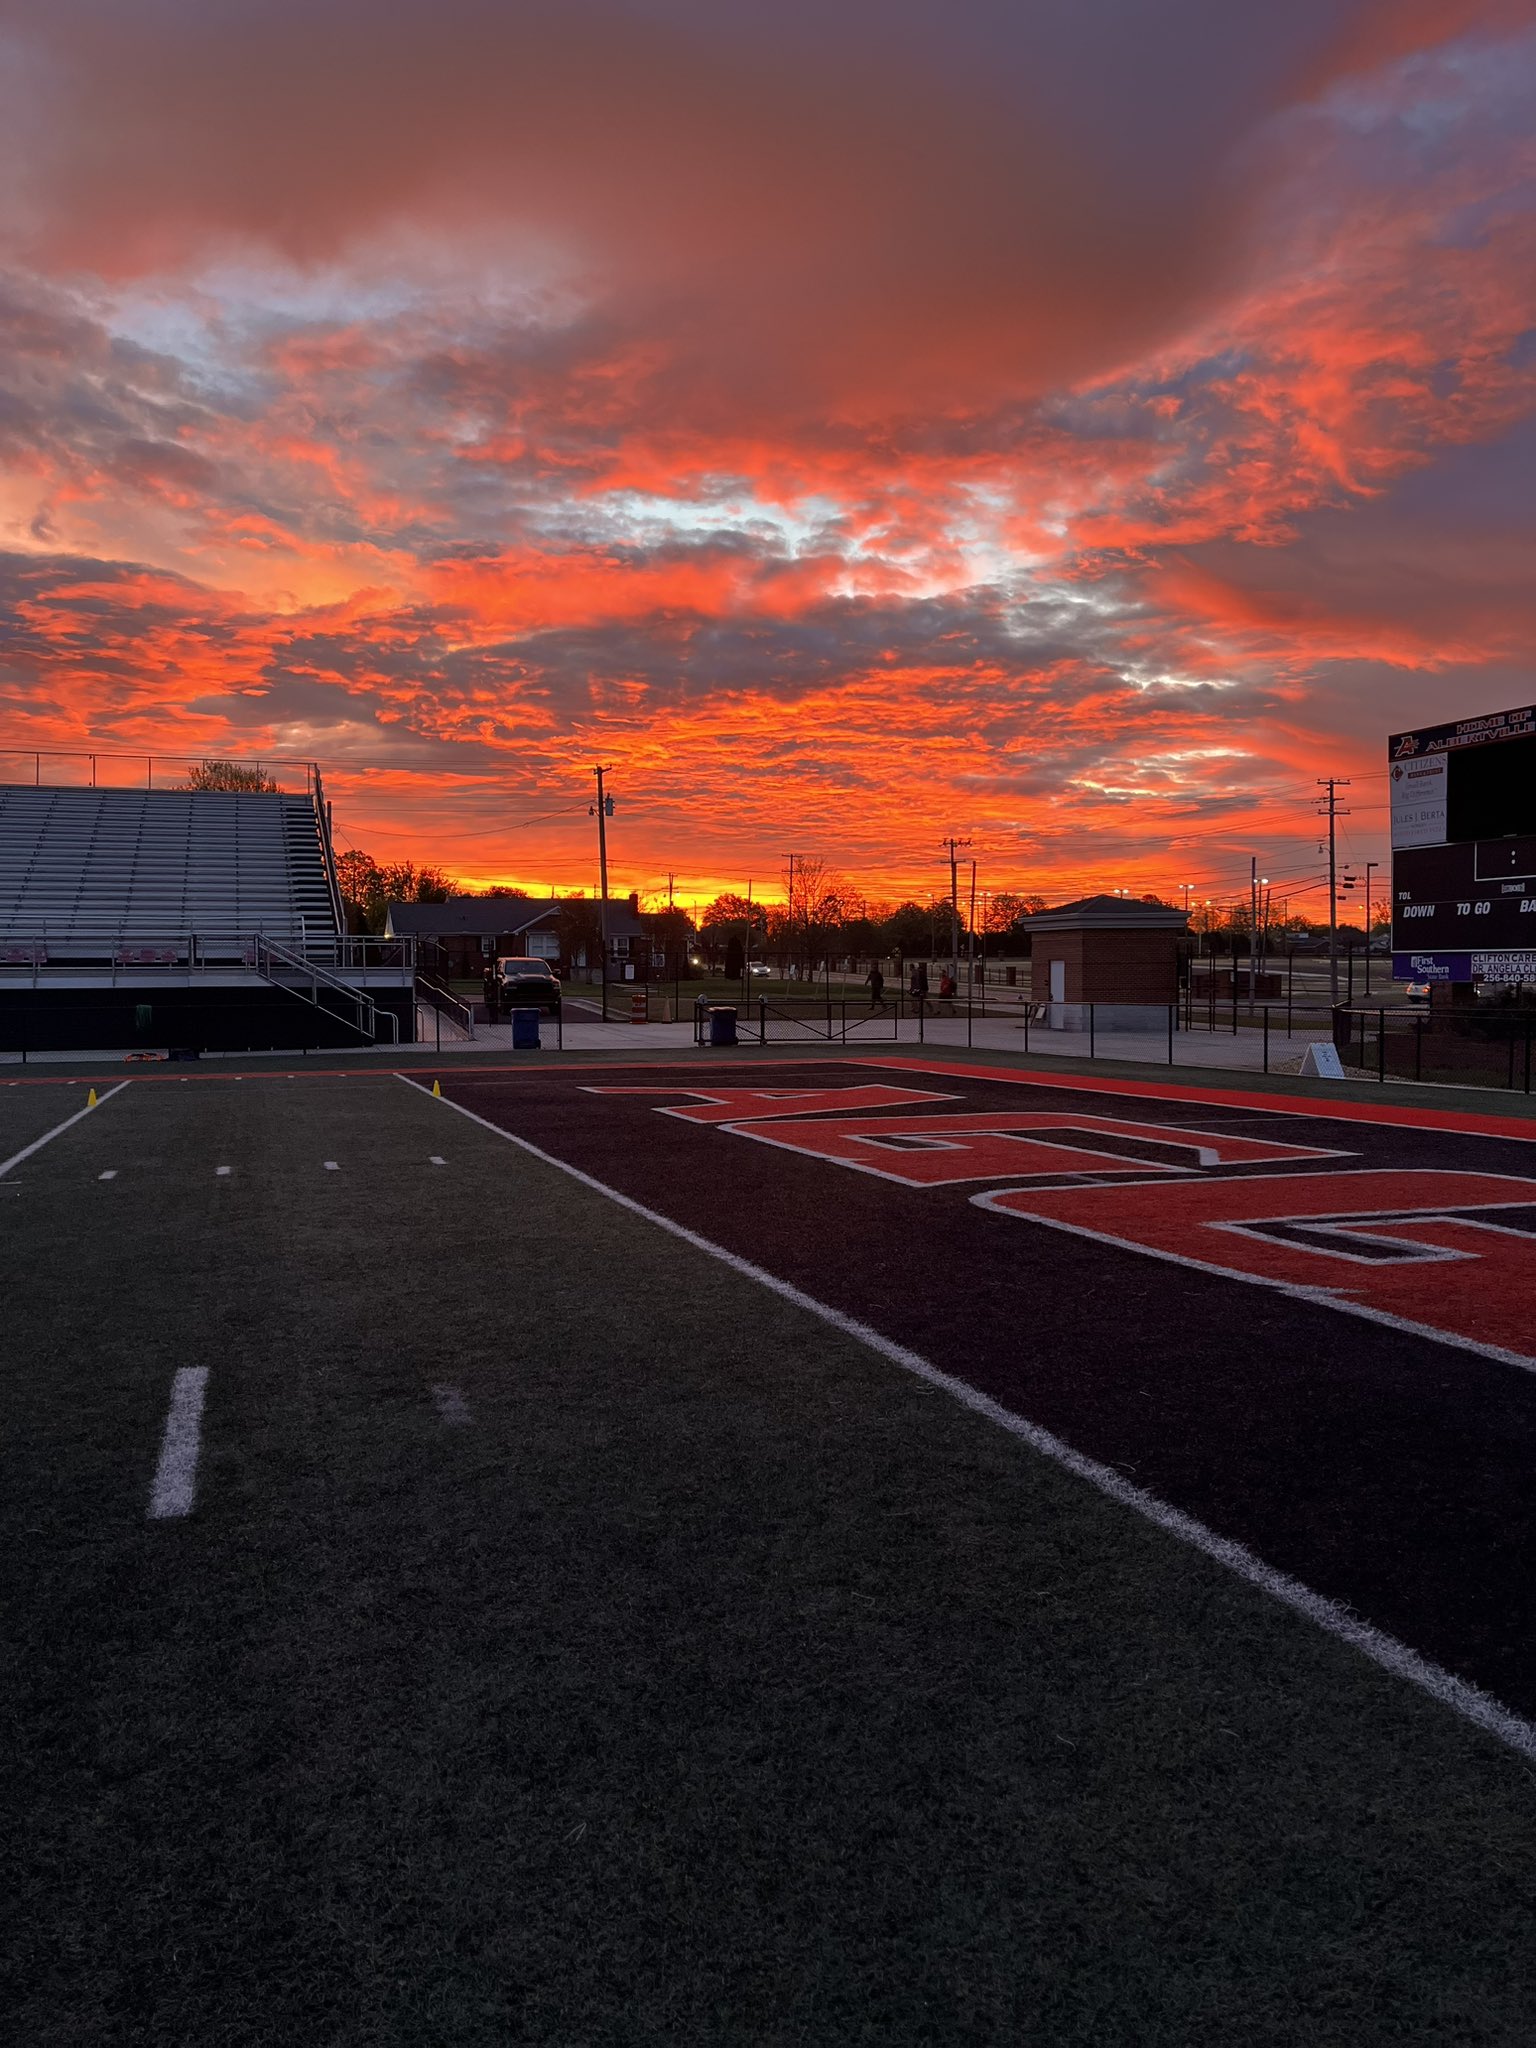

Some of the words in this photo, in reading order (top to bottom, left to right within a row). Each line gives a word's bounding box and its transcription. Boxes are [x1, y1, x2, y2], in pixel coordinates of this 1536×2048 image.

[1456, 715, 1505, 735] HOME
[1508, 710, 1532, 724] OF
[1425, 721, 1535, 752] ALBERTVILLE
[1420, 810, 1445, 821] BERTA
[1398, 892, 1411, 900] TOL
[1402, 904, 1435, 918] DOWN
[1457, 902, 1471, 915] TO
[1474, 902, 1491, 915] GO
[1417, 956, 1433, 965] First
[1472, 954, 1510, 962] CLIFTON
[1417, 964, 1449, 974] Southern
[1487, 964, 1521, 973] ANGELA
